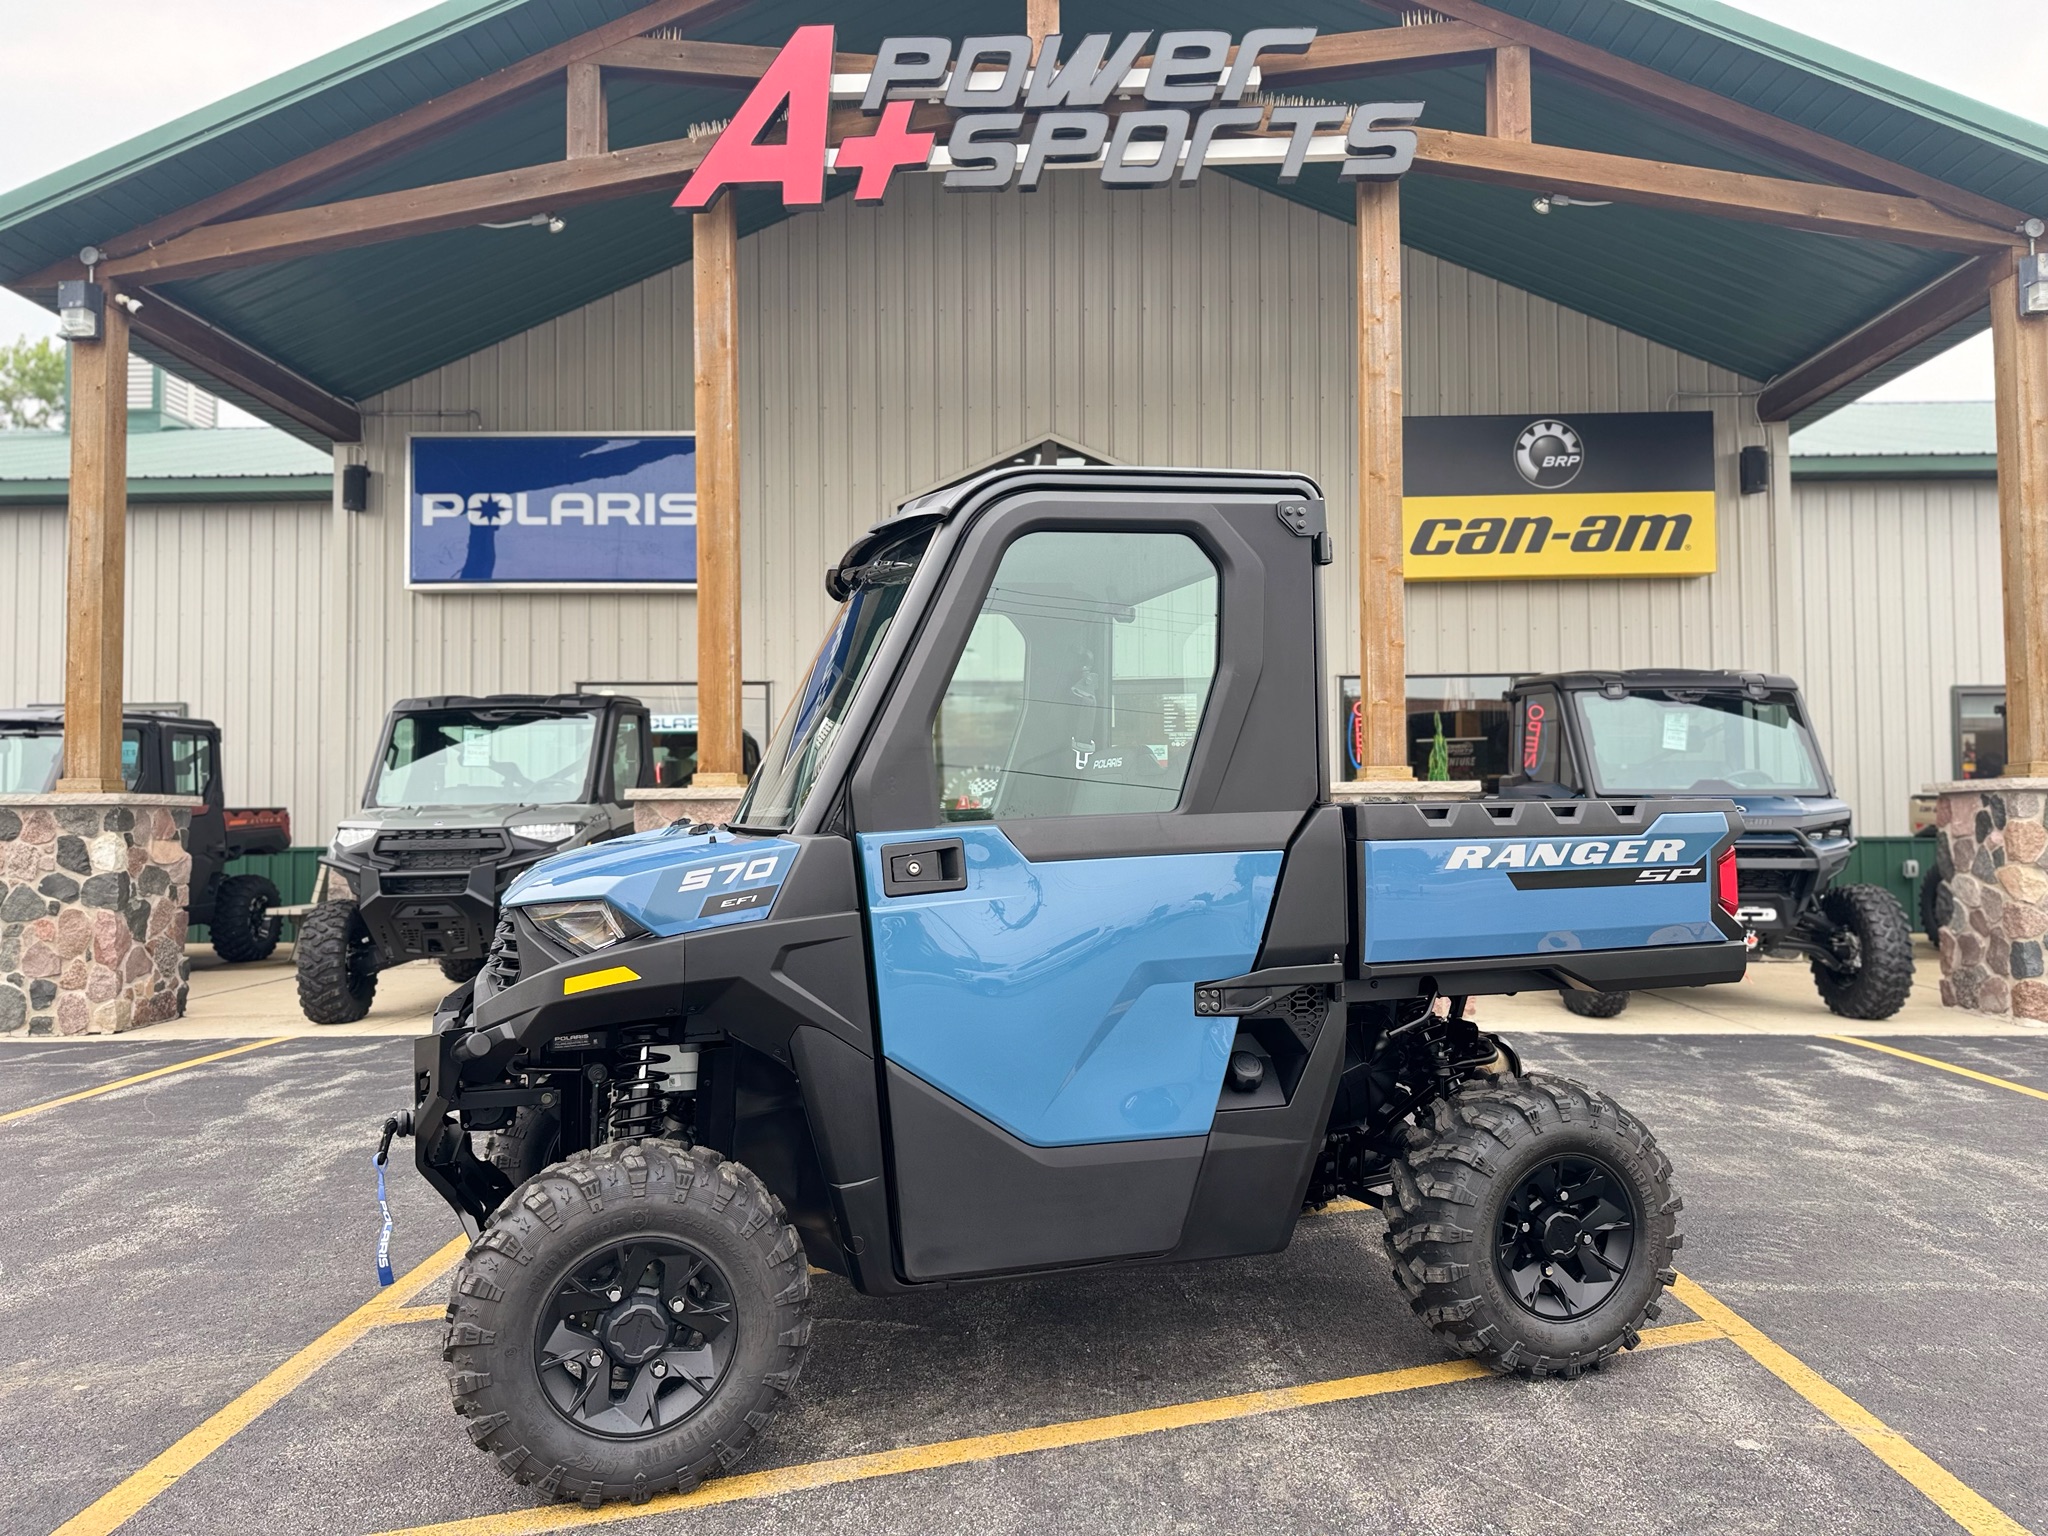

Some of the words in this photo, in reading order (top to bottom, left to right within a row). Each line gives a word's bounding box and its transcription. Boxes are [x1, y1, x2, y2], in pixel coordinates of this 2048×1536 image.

[673, 24, 936, 210] A+
[1542, 455, 1580, 467] BRP
[422, 493, 697, 526] POLARIS
[1093, 757, 1123, 769] POLARIS
[1445, 838, 1686, 870] RANGER
[1635, 867, 1702, 883] SP
[720, 894, 758, 908] EFI
[1586, 1133, 1659, 1220] X-TERRAIN
[378, 1200, 393, 1268] POLARIS
